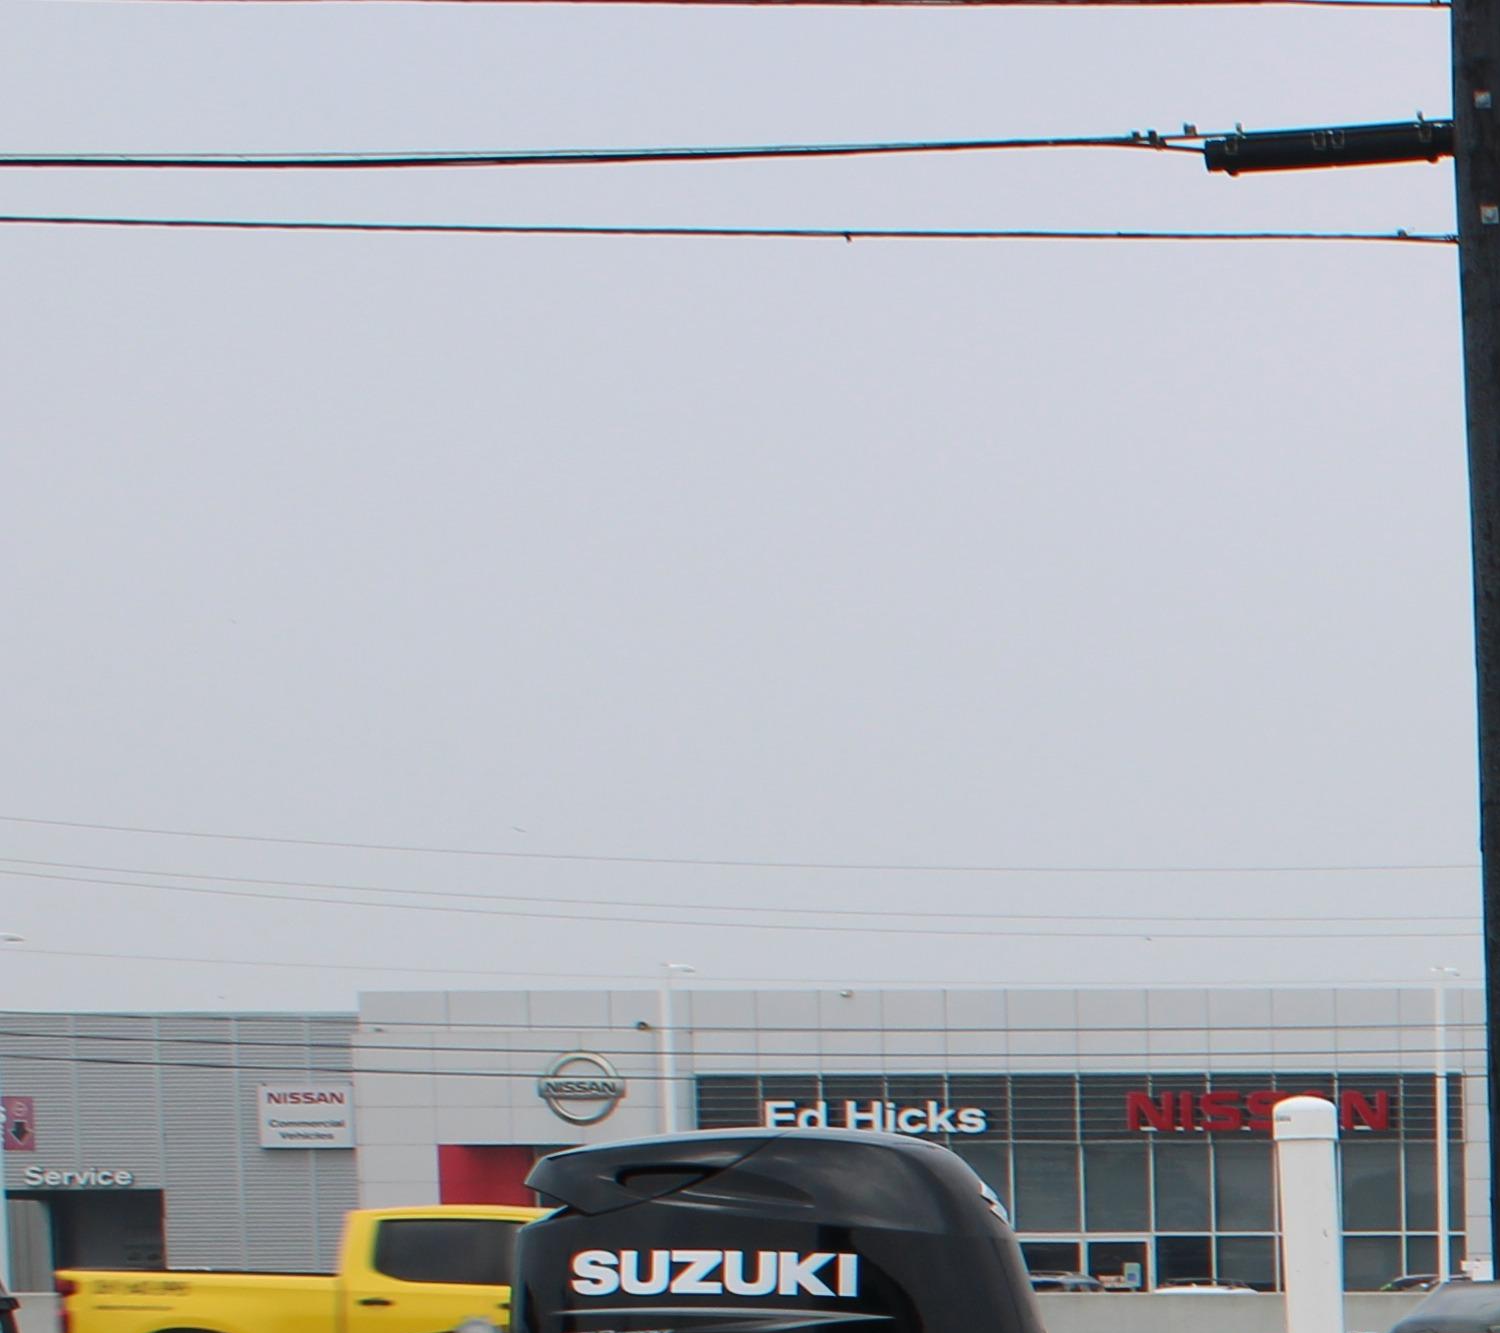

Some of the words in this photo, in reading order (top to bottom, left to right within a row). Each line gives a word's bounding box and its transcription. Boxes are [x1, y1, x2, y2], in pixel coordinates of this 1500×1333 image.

[267, 1092, 345, 1105] NISSAN
[545, 1081, 616, 1096] NISSAN
[764, 1100, 827, 1129] Ed
[846, 1100, 987, 1134] Hicks
[1125, 1091, 1389, 1131] NISSN
[24, 1167, 133, 1186] Service
[572, 1250, 858, 1297] SUZUKI
